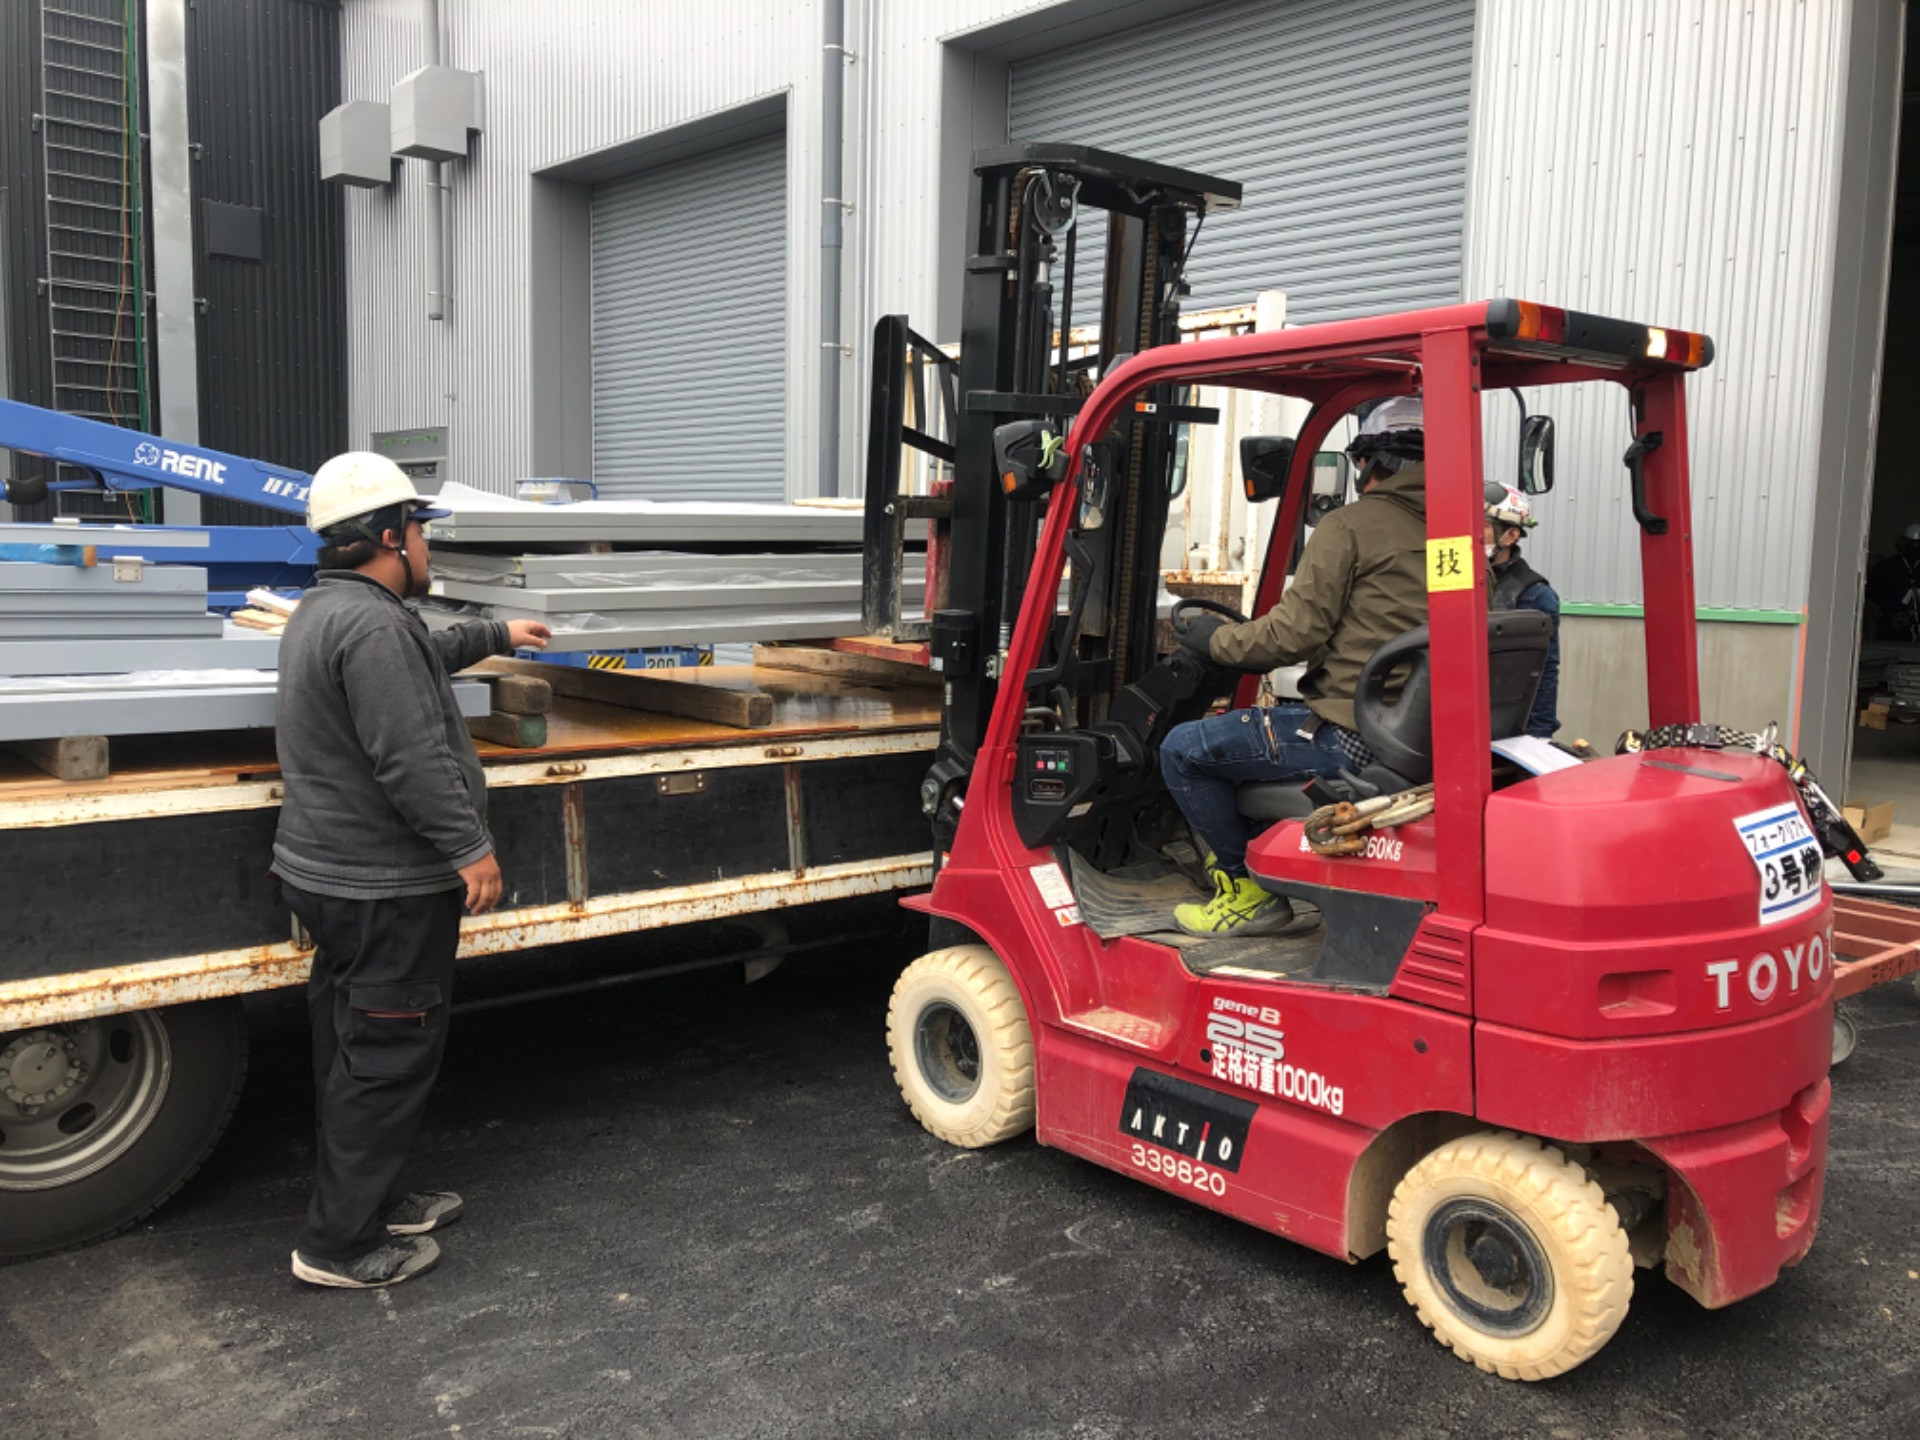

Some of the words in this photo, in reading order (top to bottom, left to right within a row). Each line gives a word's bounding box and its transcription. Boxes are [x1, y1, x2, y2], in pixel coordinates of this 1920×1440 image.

[1436, 548, 1461, 577] 技
[1207, 1012, 1284, 1060] 25
[1131, 1108, 1233, 1161] AKTIO
[1131, 1144, 1226, 1197] 339820
